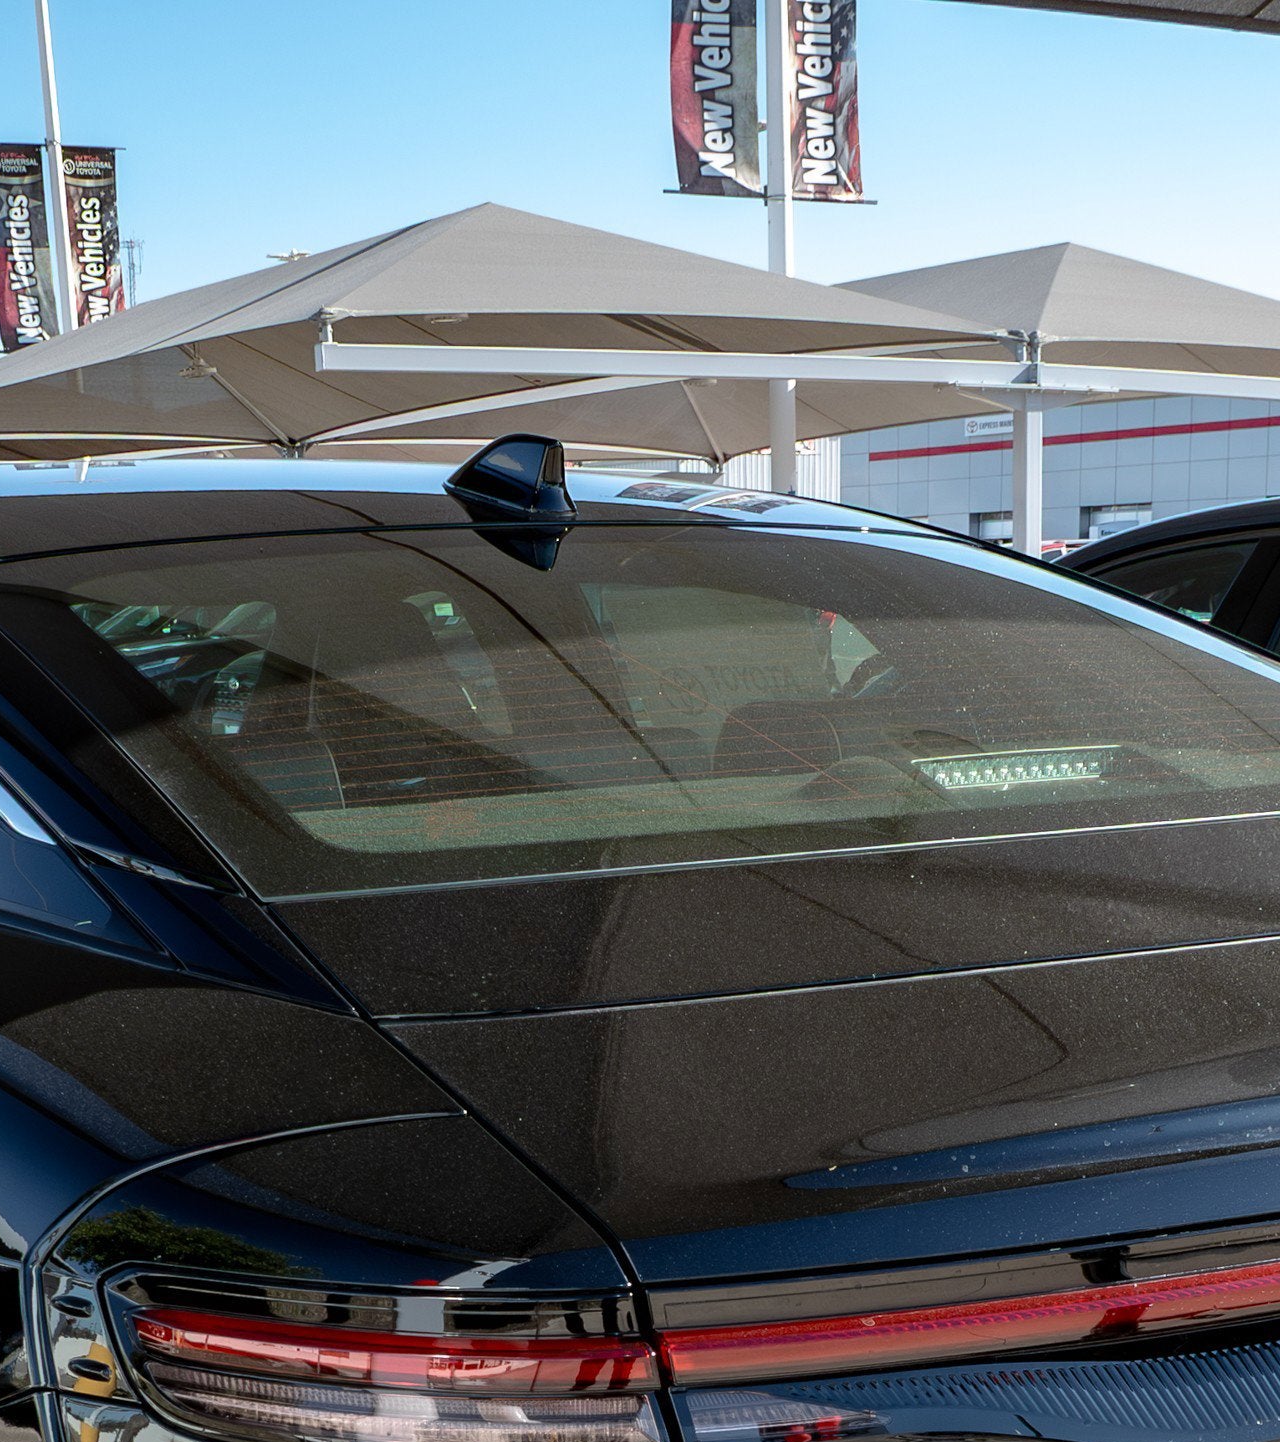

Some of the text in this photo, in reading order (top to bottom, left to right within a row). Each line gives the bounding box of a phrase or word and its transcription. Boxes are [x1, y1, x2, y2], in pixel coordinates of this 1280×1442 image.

[795, 0, 839, 186] New Vehic
[0, 157, 39, 167] UNIVERSAL
[698, 100, 737, 179] New
[1, 165, 28, 174] TOYOTA
[75, 160, 113, 170] UNIVERSAL
[75, 168, 101, 176] TOYOTA
[5, 194, 38, 292] Vehicles
[76, 197, 107, 292] Vehicles
[16, 294, 51, 344] New
